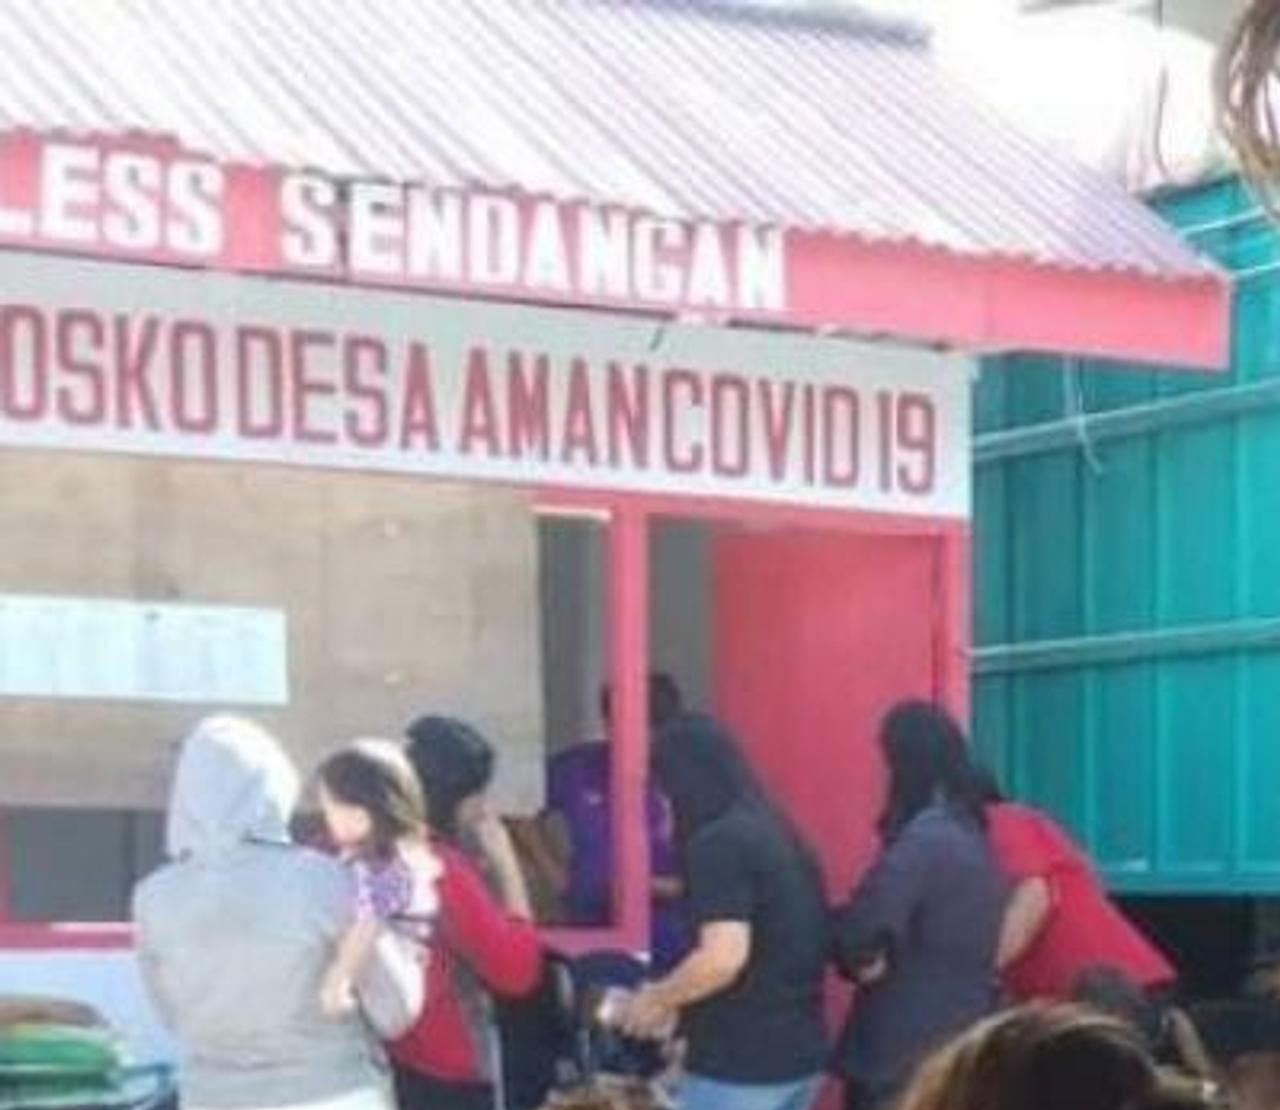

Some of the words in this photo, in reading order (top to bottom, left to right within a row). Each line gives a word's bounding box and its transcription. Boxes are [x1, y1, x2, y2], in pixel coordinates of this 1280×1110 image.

[280, 168, 788, 310] SENDANGAN
[236, 324, 441, 453] DESA
[457, 345, 650, 471] AMAN
[662, 367, 862, 490] COVID
[878, 390, 937, 496] 19
